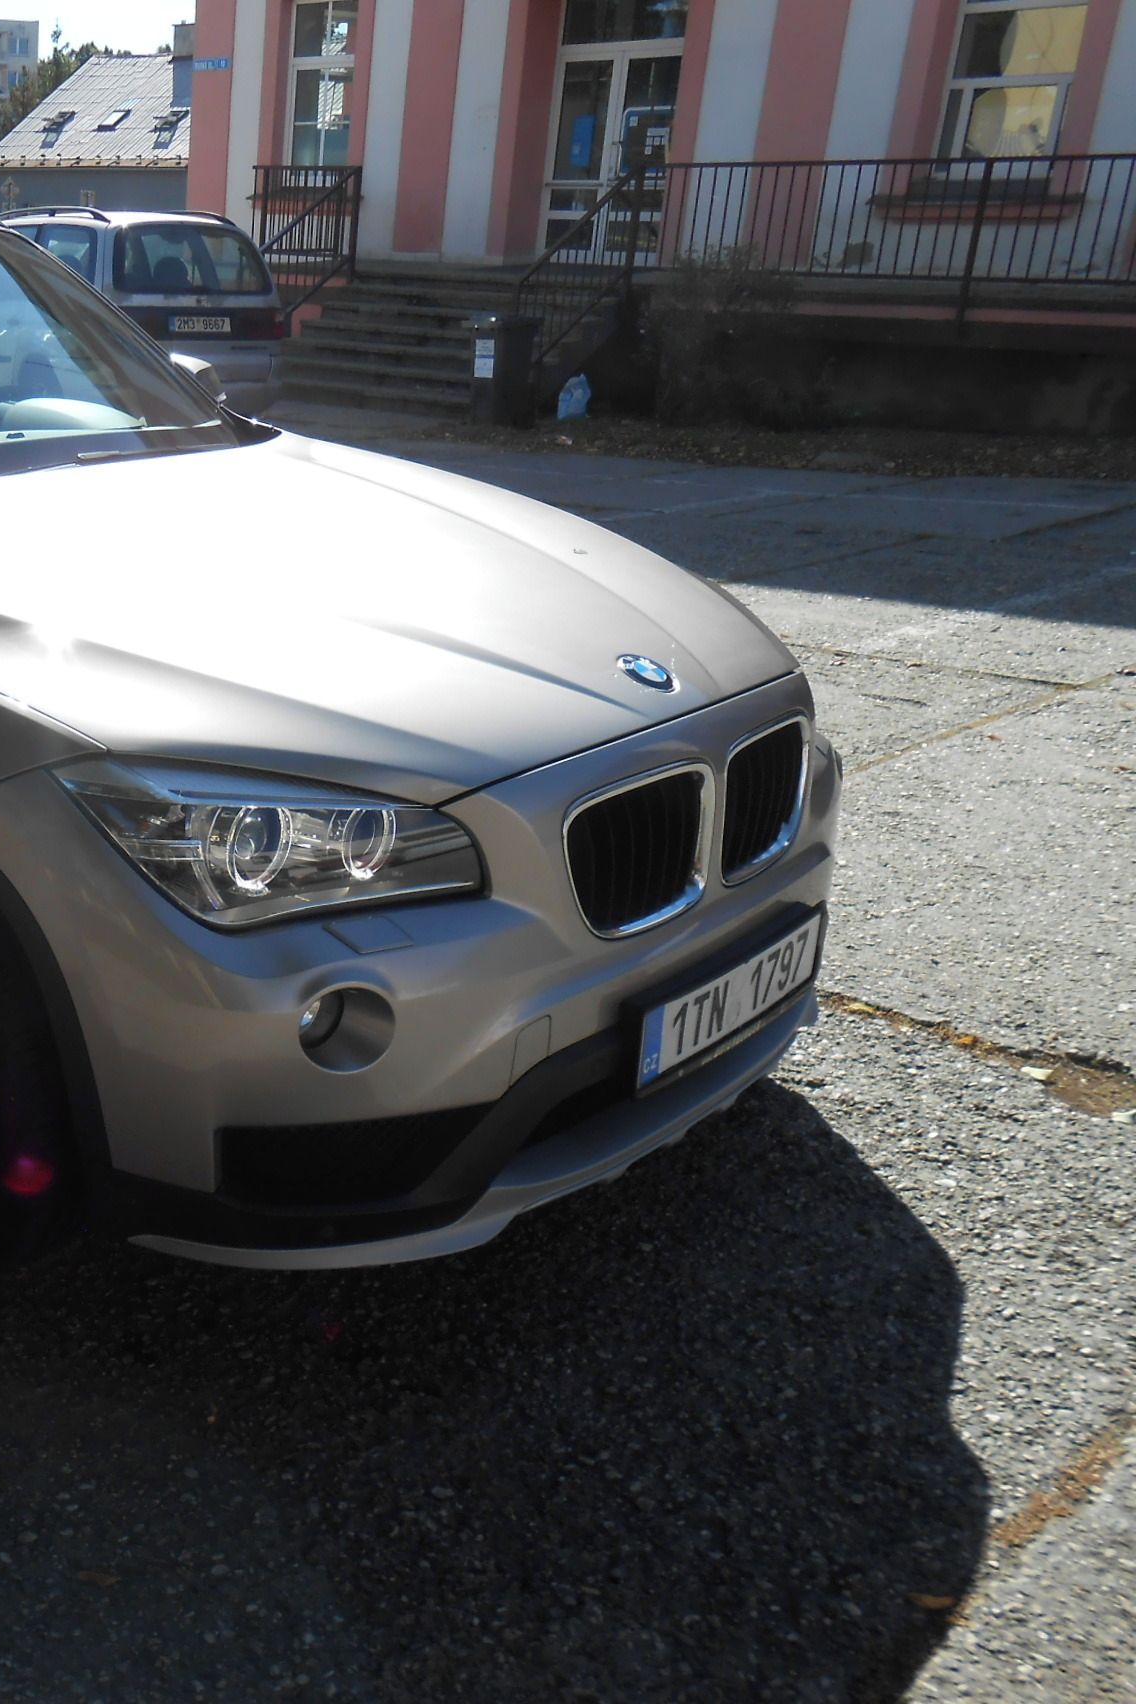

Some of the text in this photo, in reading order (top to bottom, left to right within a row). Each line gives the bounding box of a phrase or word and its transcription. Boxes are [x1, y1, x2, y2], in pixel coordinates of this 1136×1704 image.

[177, 318, 225, 330] 2M3 9667
[672, 928, 810, 1056] 1TN 1797
[642, 1054, 658, 1073] CZ
